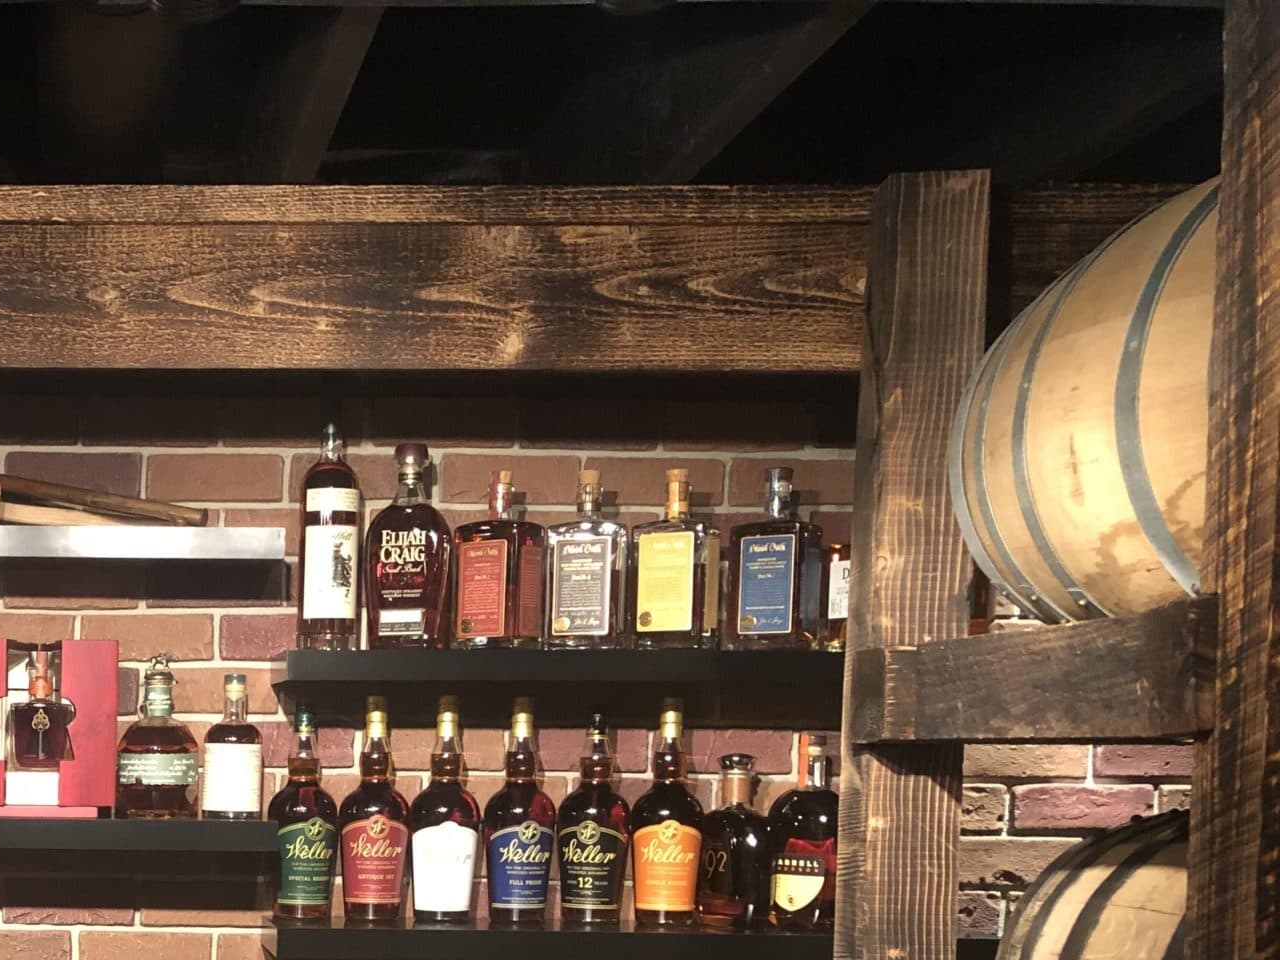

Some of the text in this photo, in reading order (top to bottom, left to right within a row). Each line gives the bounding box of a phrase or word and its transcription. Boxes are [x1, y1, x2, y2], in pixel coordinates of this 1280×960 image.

[381, 529, 427, 548] ELIJAH
[380, 546, 426, 565] CRAIG
[285, 835, 333, 860] Weller
[349, 833, 402, 858] Weller
[499, 838, 550, 864] Weller
[562, 838, 617, 864] Weller
[640, 838, 695, 864] Weller
[578, 876, 593, 889] 12
